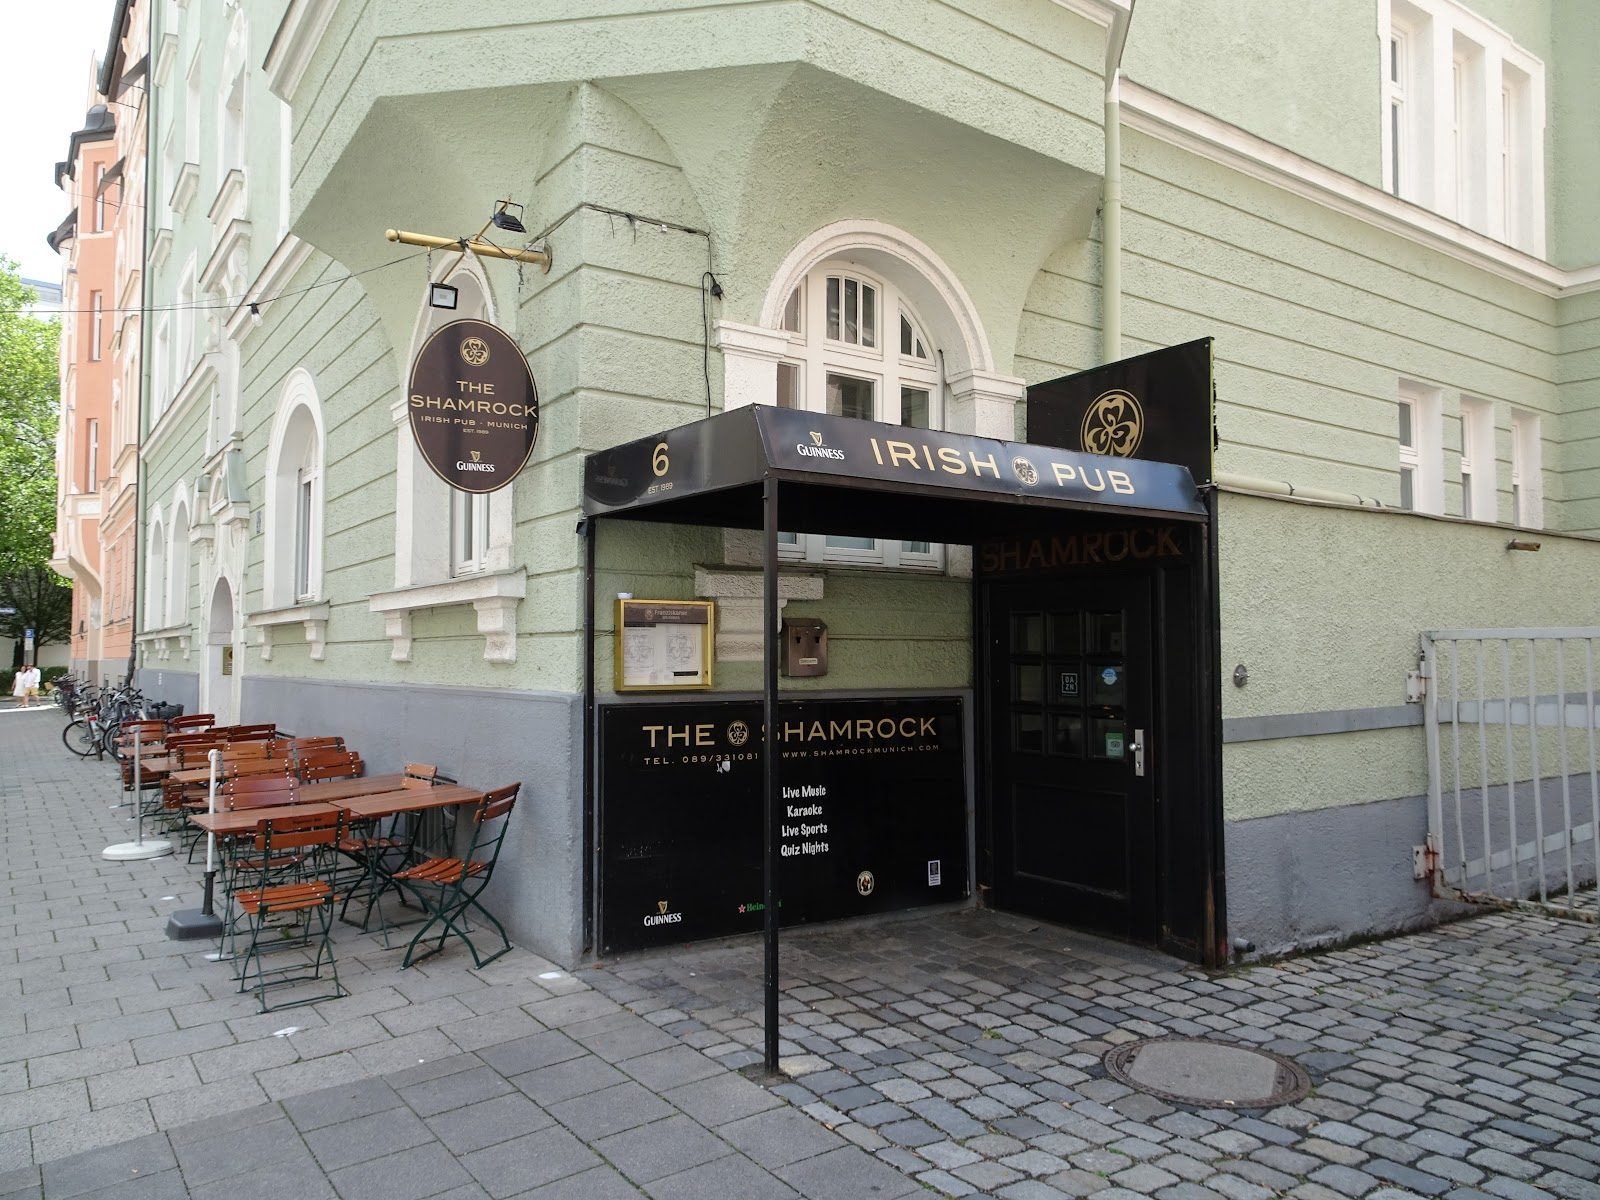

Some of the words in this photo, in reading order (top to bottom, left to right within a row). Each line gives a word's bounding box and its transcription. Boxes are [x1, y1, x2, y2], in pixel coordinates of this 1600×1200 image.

[456, 380, 495, 395] THE
[410, 394, 538, 418] SHAMROCK
[421, 415, 450, 424] IRISH
[454, 418, 476, 426] PUB
[487, 421, 528, 430] MUNICH
[796, 443, 845, 460] GUINNESS
[456, 460, 495, 473] GUINNESS
[652, 442, 669, 477] 6
[870, 437, 1002, 480] IRISH
[1052, 464, 1136, 496] PUB
[660, 482, 673, 491] 1989
[982, 527, 1184, 573] SHAMROCK
[642, 723, 716, 748] THE
[643, 757, 675, 766] TEL.
[682, 752, 759, 764] 089/331081
[782, 744, 939, 759] WWW.SHAMROCKMUNICH.COM
[782, 786, 800, 799] Live
[801, 784, 827, 798] Music
[787, 803, 823, 818] Karaoke
[781, 824, 800, 837] Live
[800, 823, 828, 837] Sports
[780, 844, 801, 857] Quiz
[801, 841, 829, 855] Nights
[643, 912, 682, 927] GUINNESS
